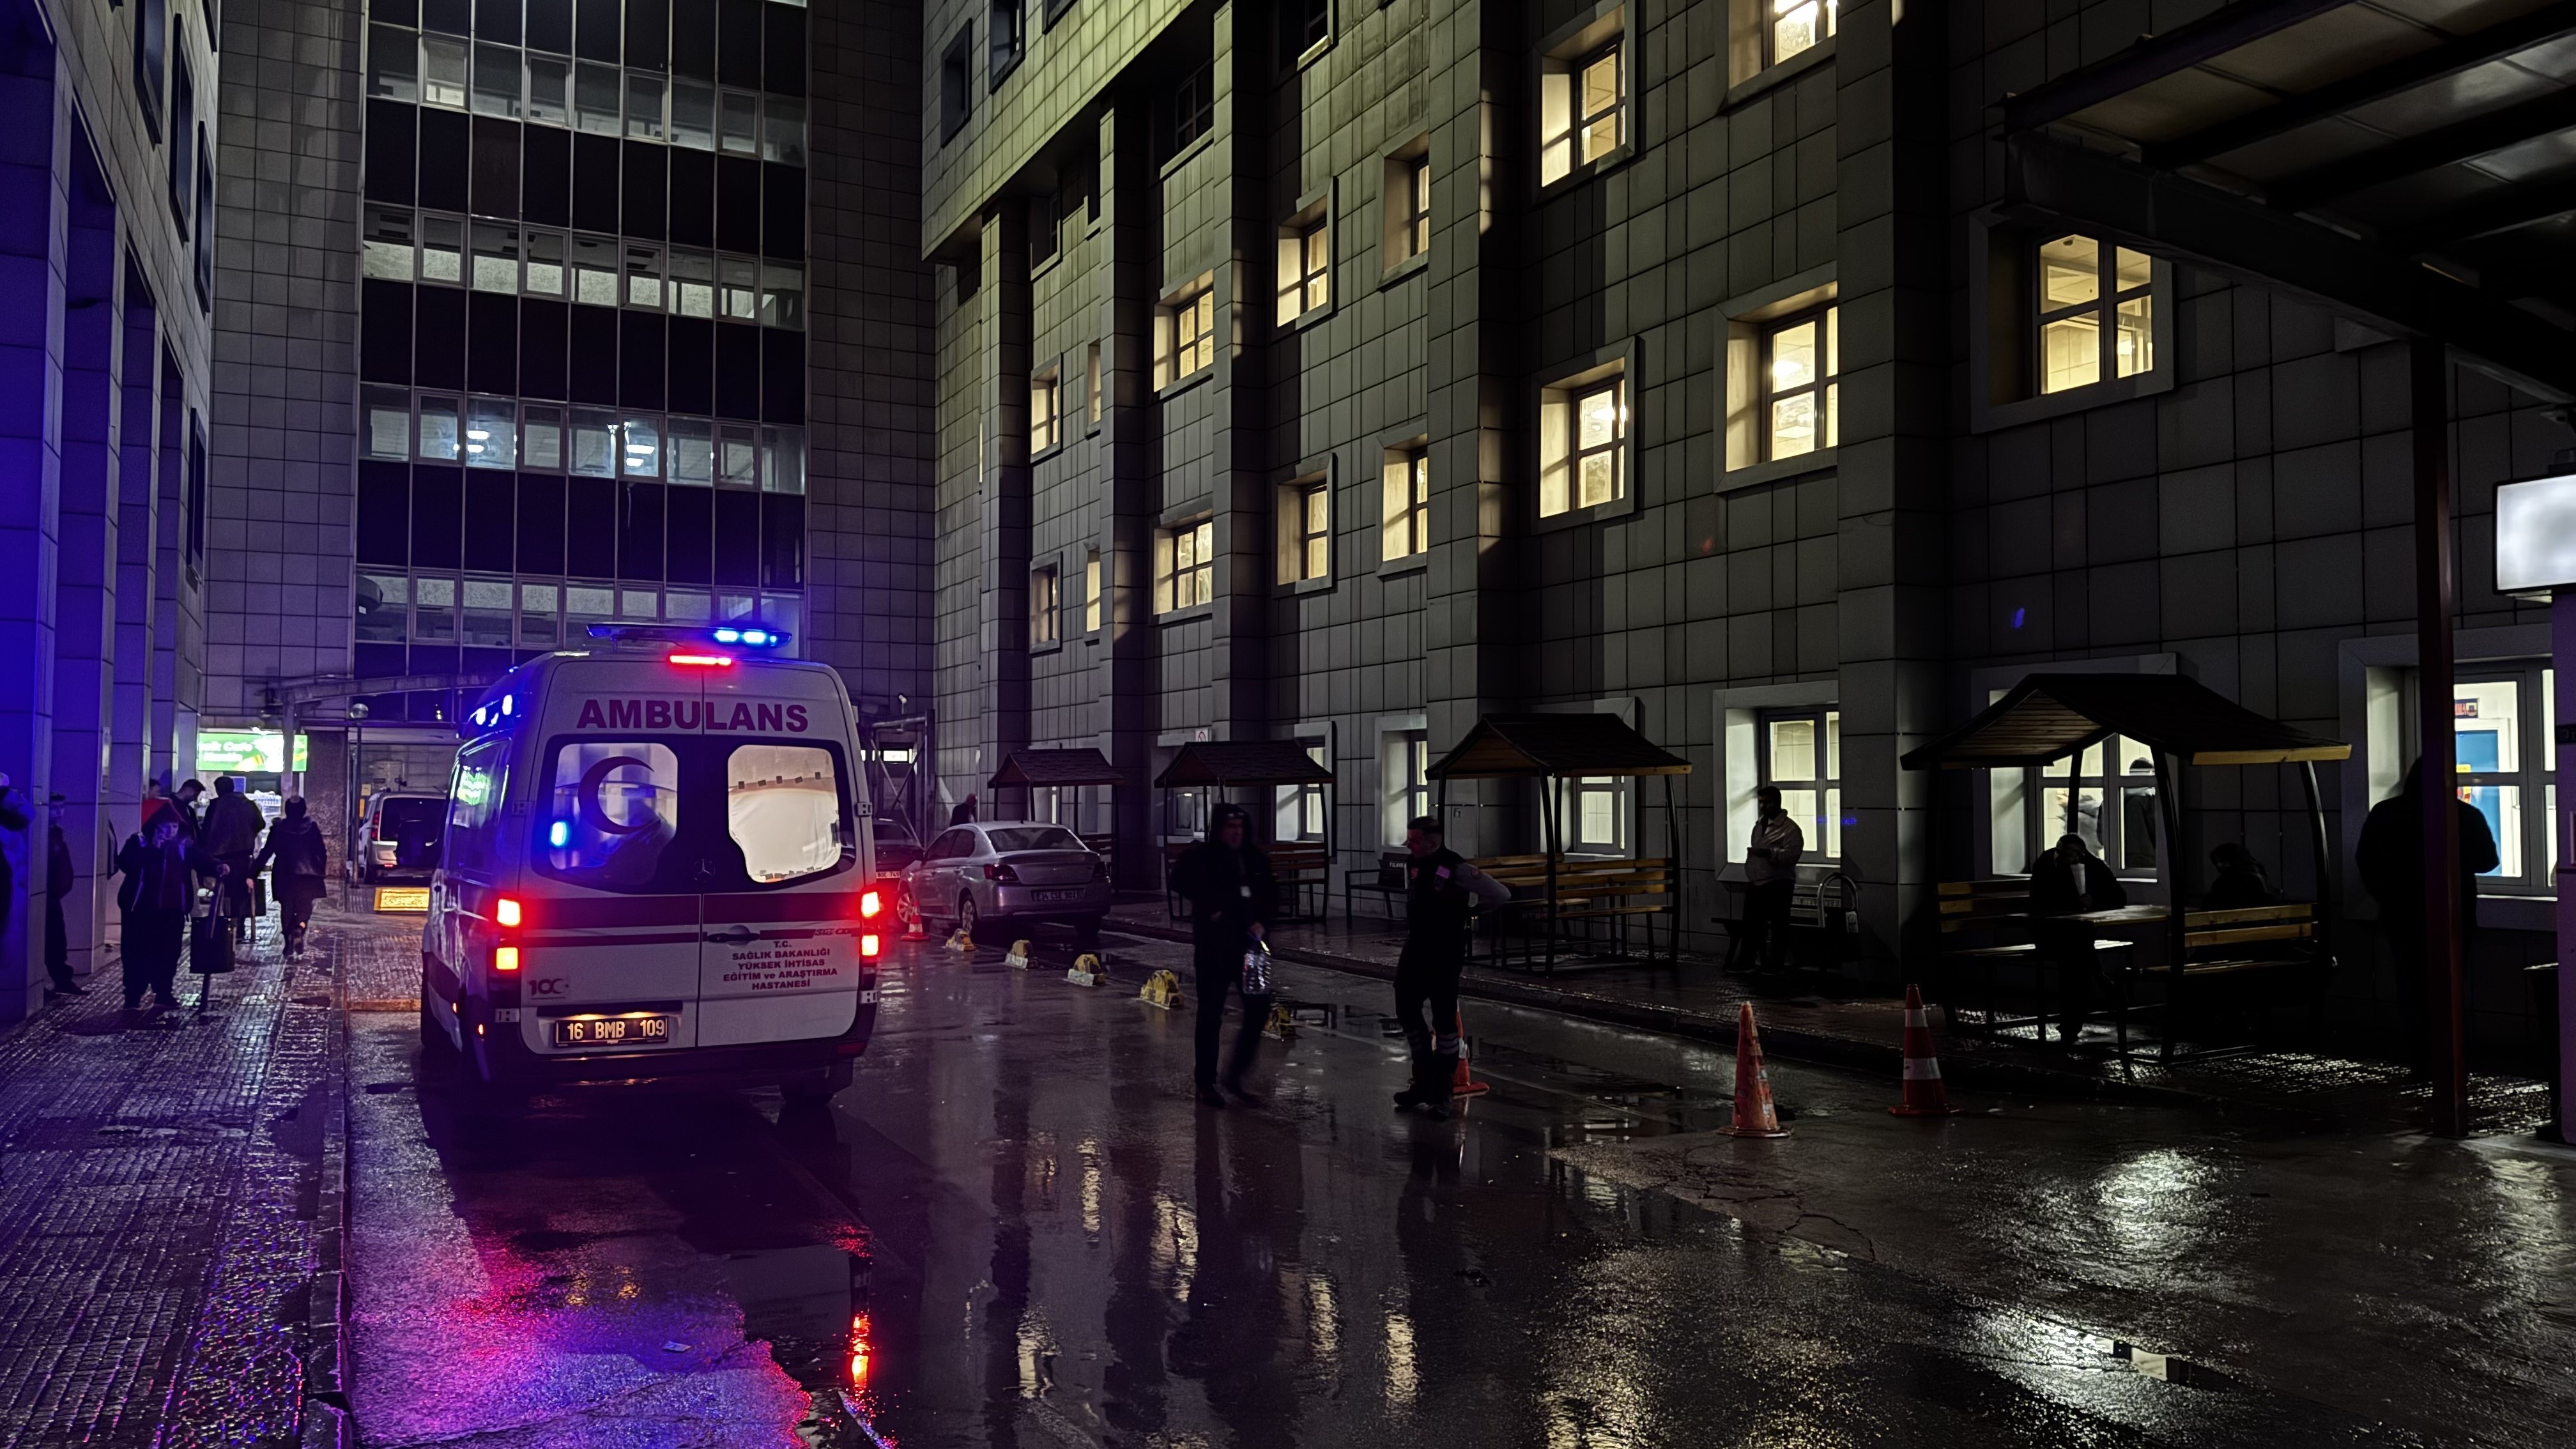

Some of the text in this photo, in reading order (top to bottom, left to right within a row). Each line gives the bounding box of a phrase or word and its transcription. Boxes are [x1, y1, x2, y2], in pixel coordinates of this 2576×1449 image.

[576, 700, 808, 733] AMBULANS
[732, 948, 830, 960] SAĞLIK BAKANLIĞI
[738, 958, 825, 970] YÜKSEK İHTİSAS
[723, 972, 760, 981] EĞİTİM
[779, 969, 838, 979] ARAŞTIRMA
[752, 979, 810, 990] HASTANESİ
[567, 1020, 665, 1040] 16 BMB 109
